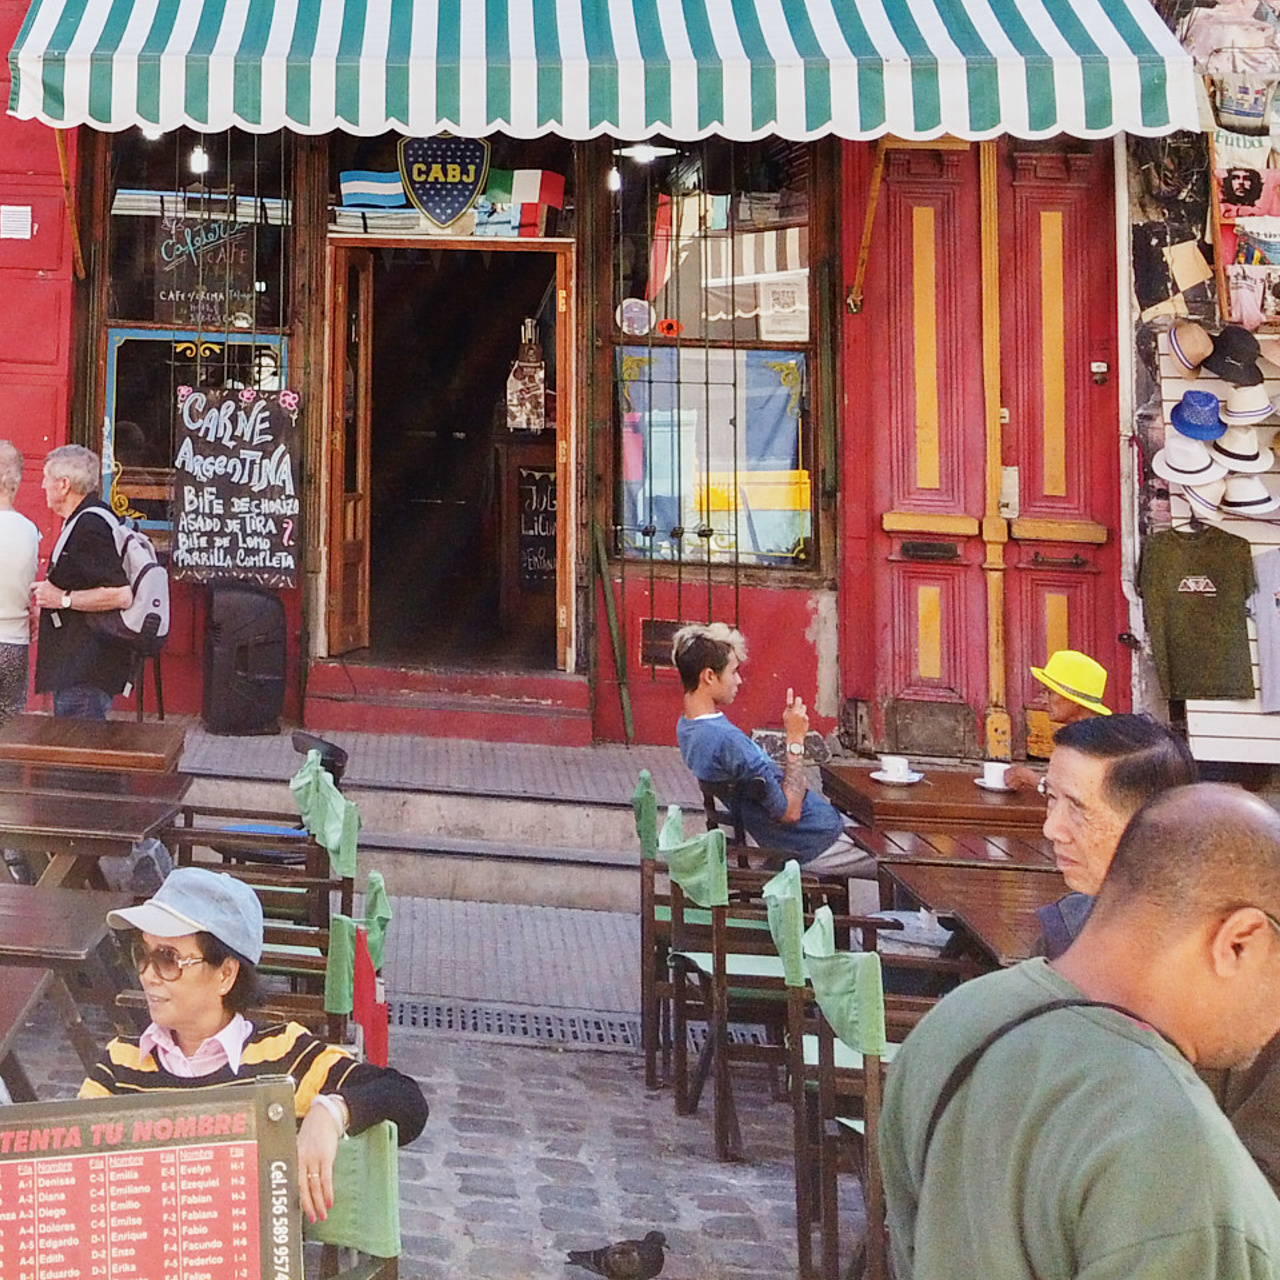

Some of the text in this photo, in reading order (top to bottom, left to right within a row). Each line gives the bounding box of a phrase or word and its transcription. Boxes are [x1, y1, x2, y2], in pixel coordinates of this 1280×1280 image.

[412, 163, 476, 183] CABJ
[183, 392, 273, 448] CARNE
[520, 485, 557, 511] JUG
[231, 497, 250, 513] DE
[251, 494, 300, 516] CHORIZO
[179, 512, 221, 532] ASADO
[239, 513, 277, 535] TIRA
[173, 548, 233, 568] PARRILLA
[91, 1122, 124, 1147] TU
[132, 1112, 248, 1143] NOMBRE
[109, 1155, 144, 1168] Nombre
[180, 1149, 214, 1162] Nombre
[38, 1162, 73, 1174] Nombre
[180, 1164, 211, 1176] Evelyn
[110, 1170, 139, 1181] Emilia
[38, 1176, 76, 1188] Denisse
[181, 1177, 219, 1191] Ezequiel
[110, 1184, 151, 1196] Emiliano
[38, 1192, 65, 1202] Diana
[181, 1194, 212, 1205] Fabian
[38, 1208, 66, 1219] Diego
[182, 1210, 218, 1221] Fabiana
[111, 1215, 142, 1227] Emilse
[39, 1222, 75, 1234] Dolores
[182, 1224, 208, 1236] Fabio
[273, 1217, 289, 1244] 589
[39, 1236, 79, 1249] Edgardo
[111, 1231, 148, 1243] Enrique
[182, 1239, 223, 1251] Facundo
[39, 1253, 65, 1264] Edith
[111, 1247, 135, 1258] Enzo
[183, 1255, 223, 1267] Federico
[40, 1268, 80, 1280] Eduardo
[112, 1263, 136, 1274] Erika
